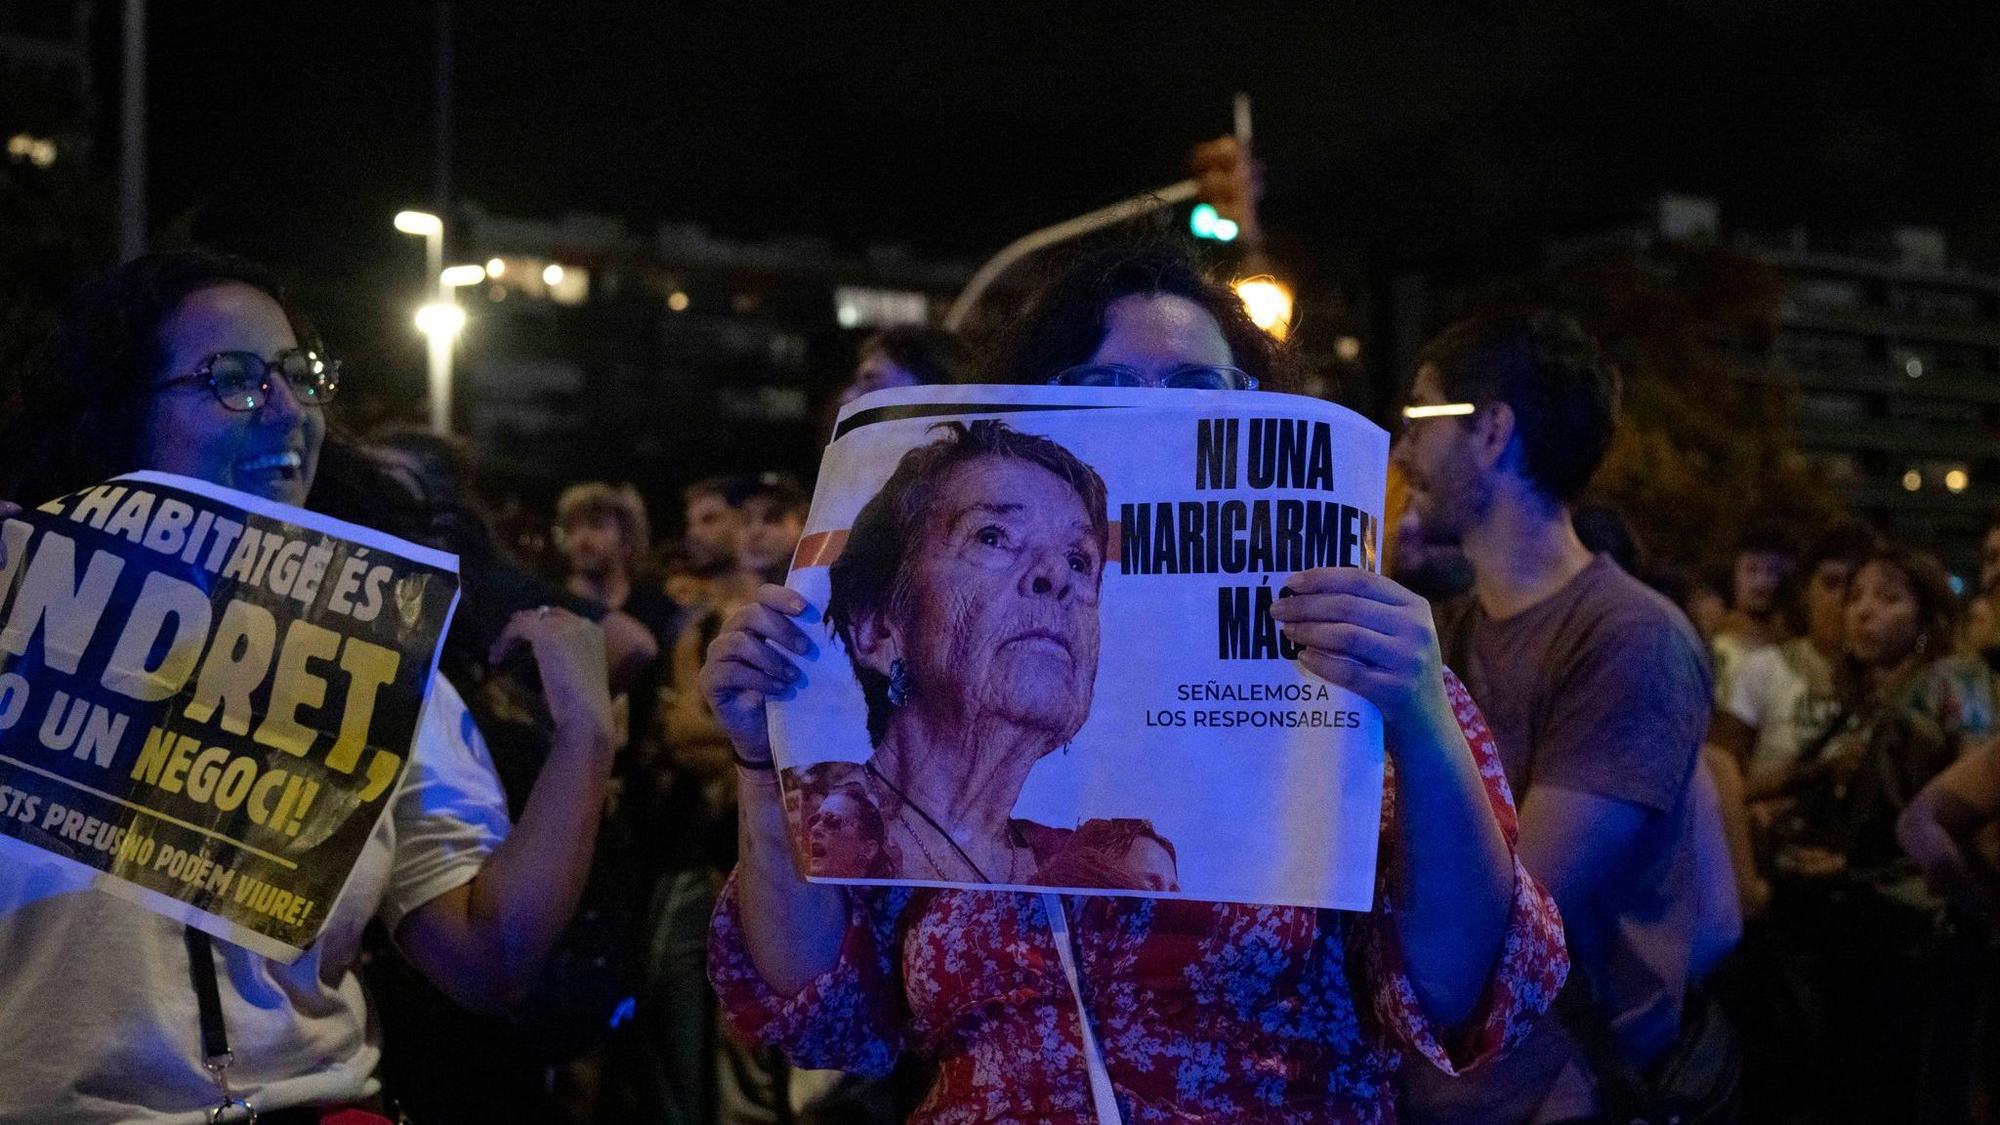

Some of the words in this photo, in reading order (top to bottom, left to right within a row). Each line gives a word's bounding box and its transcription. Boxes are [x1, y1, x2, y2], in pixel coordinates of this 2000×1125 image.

[1196, 418, 1239, 490] NI
[1247, 418, 1334, 491] UNA
[1120, 499, 1377, 575] MARICARMEN
[328, 548, 394, 622] ÉS
[100, 570, 400, 802] DRET,
[1146, 710, 1186, 727] LOS
[1193, 710, 1360, 728] RESPONSABLES
[1177, 680, 1312, 701] SEÑALEMOS
[1316, 685, 1329, 701] A
[38, 690, 130, 769] UN
[130, 726, 320, 837] NEGOCI!
[41, 802, 126, 855] PREUS
[154, 844, 236, 896] PODEM
[234, 875, 314, 927] VIURE!
